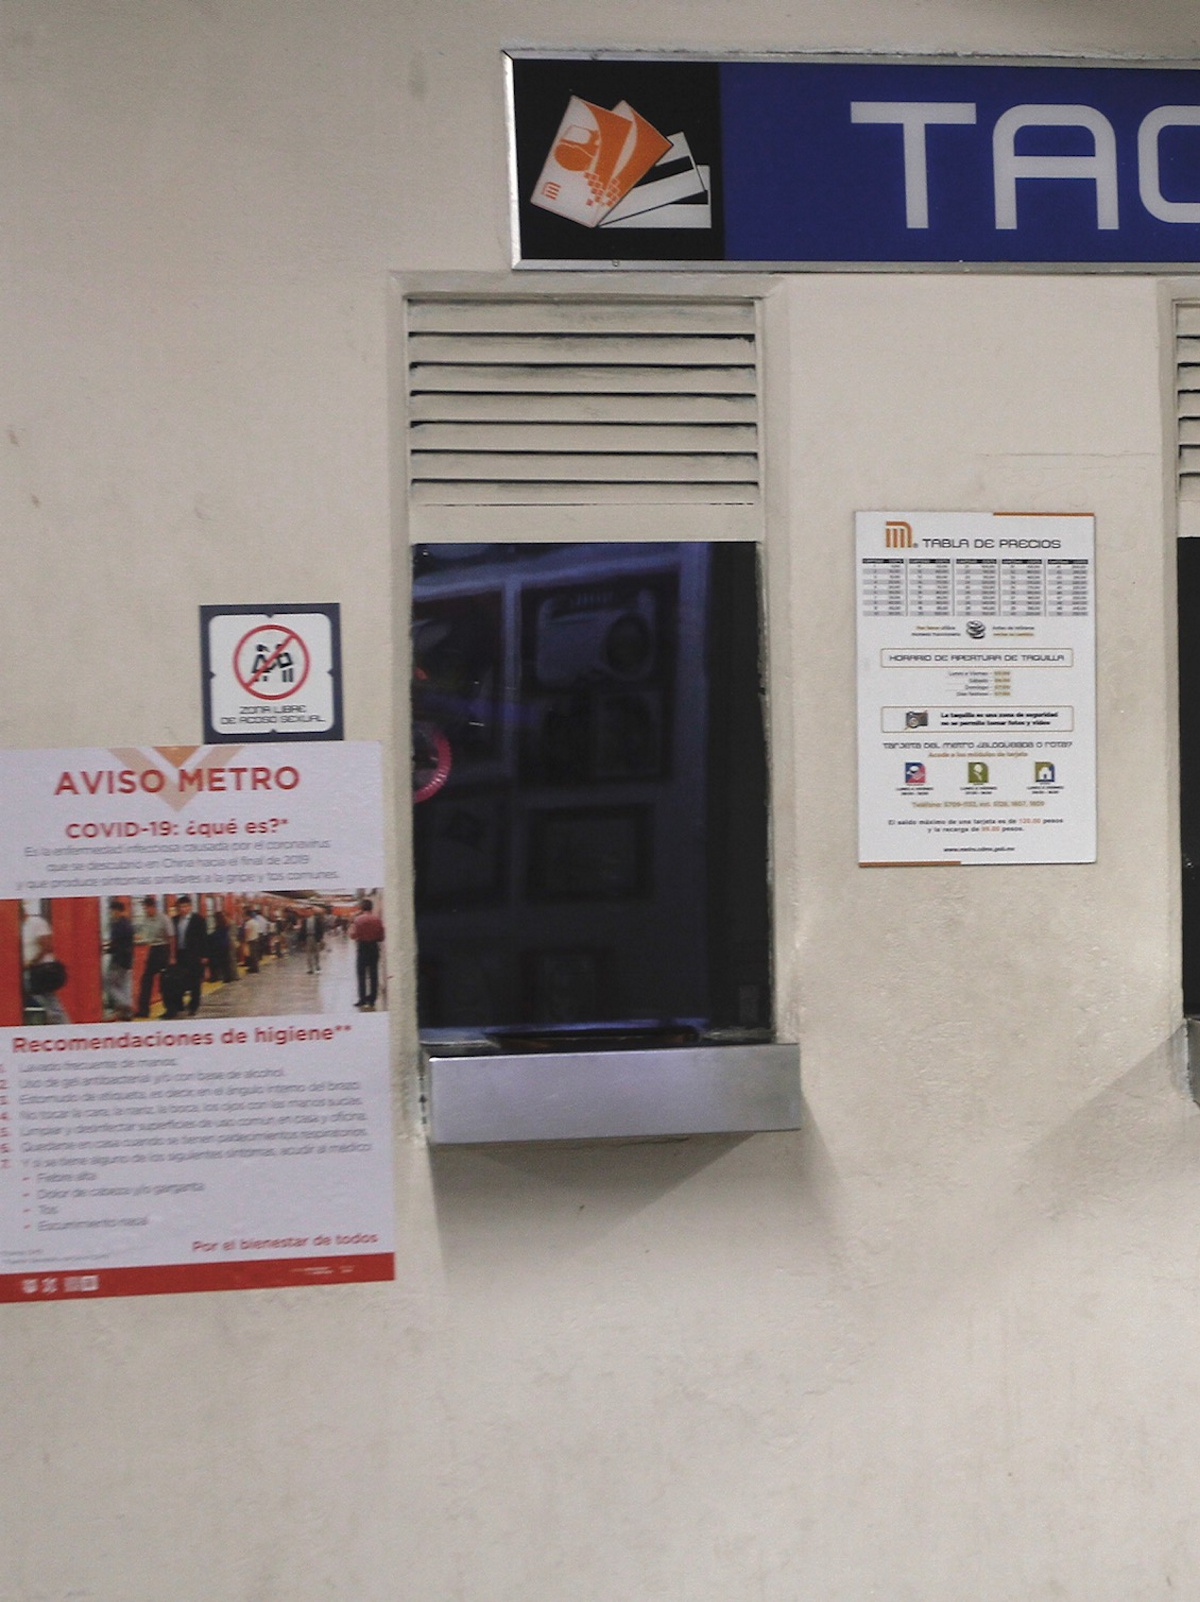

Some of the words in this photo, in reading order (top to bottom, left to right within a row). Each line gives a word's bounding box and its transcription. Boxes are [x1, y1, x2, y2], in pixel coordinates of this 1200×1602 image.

[922, 538, 969, 549] TABLA
[973, 538, 995, 549] DE
[998, 538, 1061, 549] PRECIOS
[889, 654, 932, 662] HORARIO
[934, 654, 948, 662] DE
[951, 654, 1002, 662] APERTURA
[1004, 654, 1018, 662] DE
[1021, 654, 1064, 662] TAQUILLA
[239, 706, 270, 714] ZONA
[274, 705, 306, 714] LIBRE
[220, 717, 236, 725] DE
[239, 716, 277, 724] ACOSO
[280, 715, 326, 724] SEXUAL
[54, 768, 165, 796] AVISO
[177, 766, 299, 793] METRO
[973, 818, 996, 826] tarjeta
[1008, 817, 1017, 825] de
[65, 820, 178, 838] COVID-19:
[185, 818, 237, 837] ¿qué
[12, 1031, 213, 1054] Recomendaciones
[220, 1028, 248, 1044] de
[192, 1240, 218, 1251] Por
[222, 1239, 236, 1250] el
[240, 1235, 309, 1250] bienestar
[312, 1233, 332, 1246] de
[336, 1232, 379, 1245] todos
